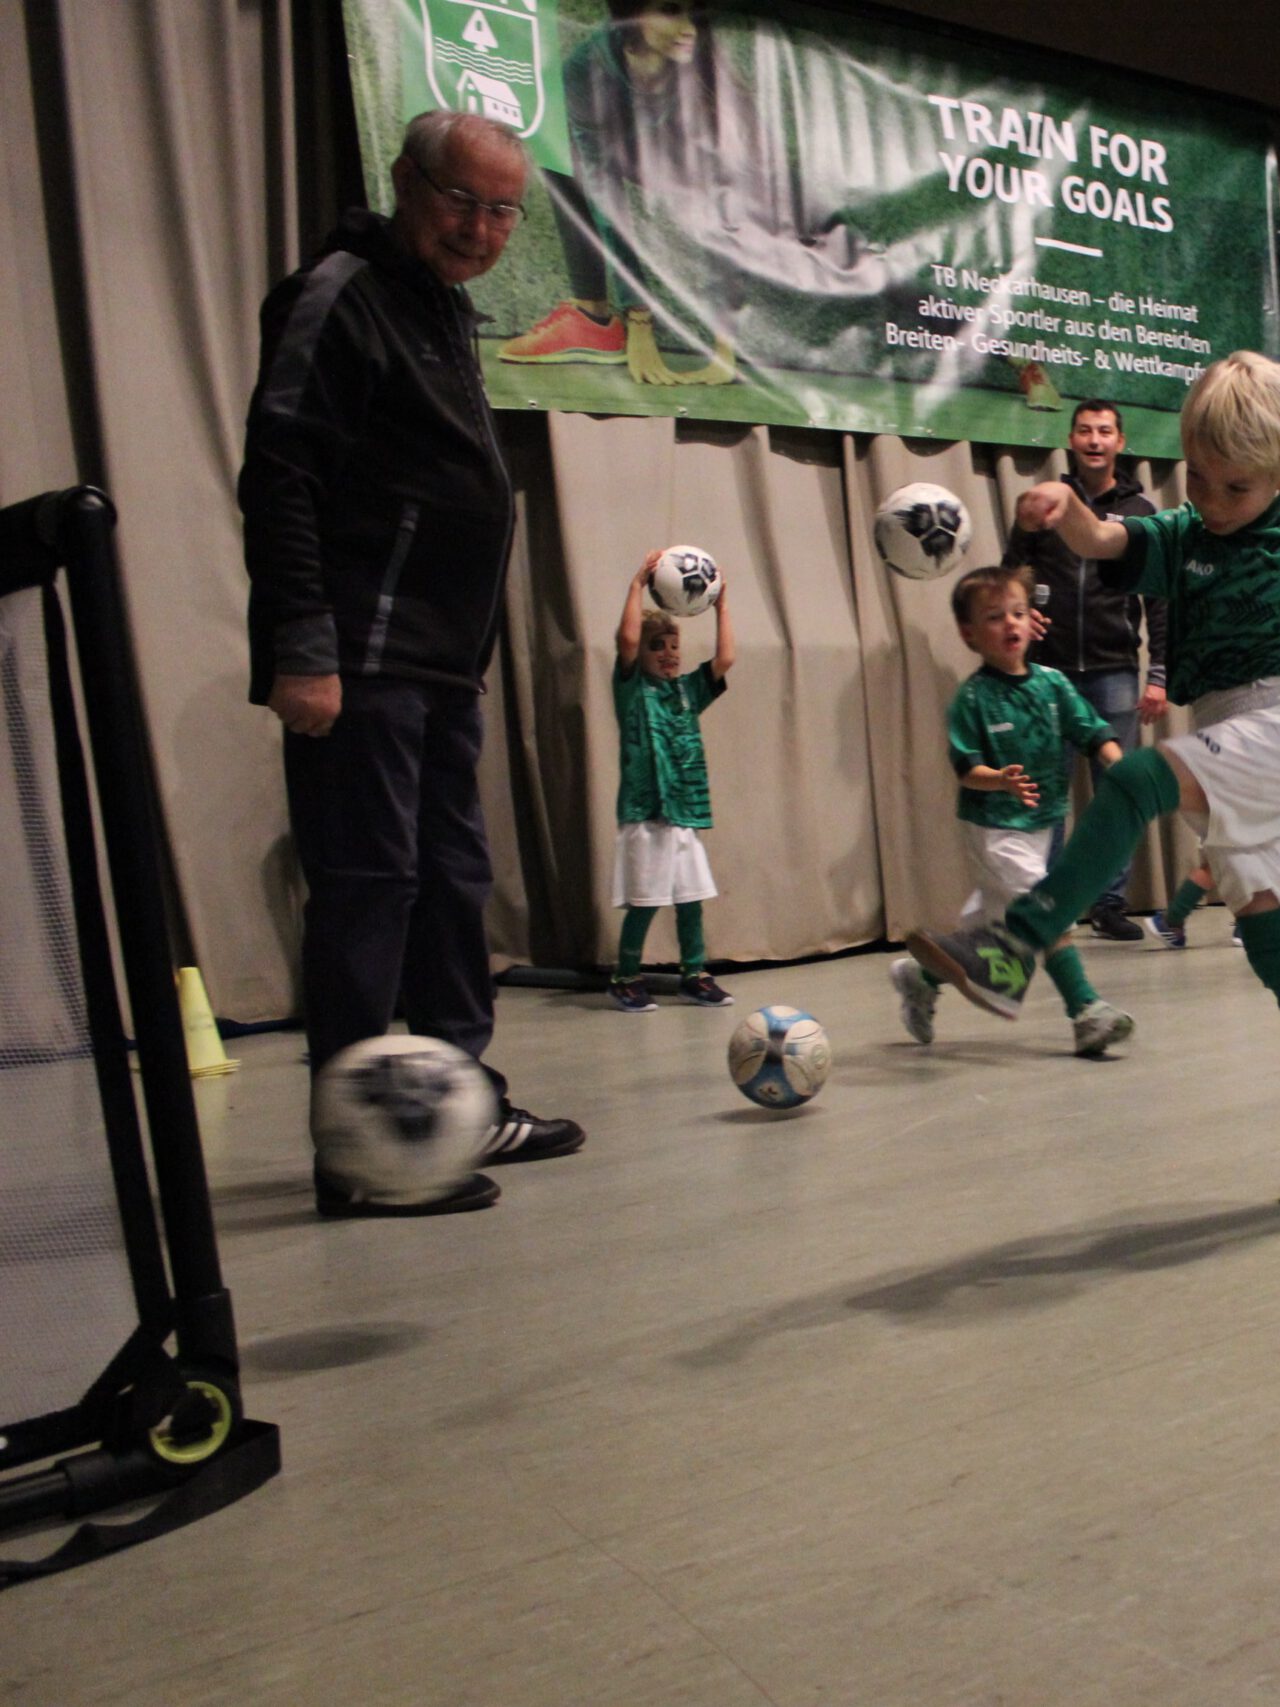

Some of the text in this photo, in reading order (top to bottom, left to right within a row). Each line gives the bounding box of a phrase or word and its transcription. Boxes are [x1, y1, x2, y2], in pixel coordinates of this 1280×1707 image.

[928, 95, 1169, 186] TRAIN FOR
[939, 151, 1174, 233] YOUR GOALS
[931, 264, 958, 288] TB
[1108, 291, 1136, 315] die
[1139, 296, 1199, 323] Heimat
[918, 294, 1212, 354] aktiver Sportler aus den Bereichen
[971, 333, 1090, 367] Gesundheits-
[1094, 348, 1112, 370] &
[1184, 558, 1215, 576] AKO
